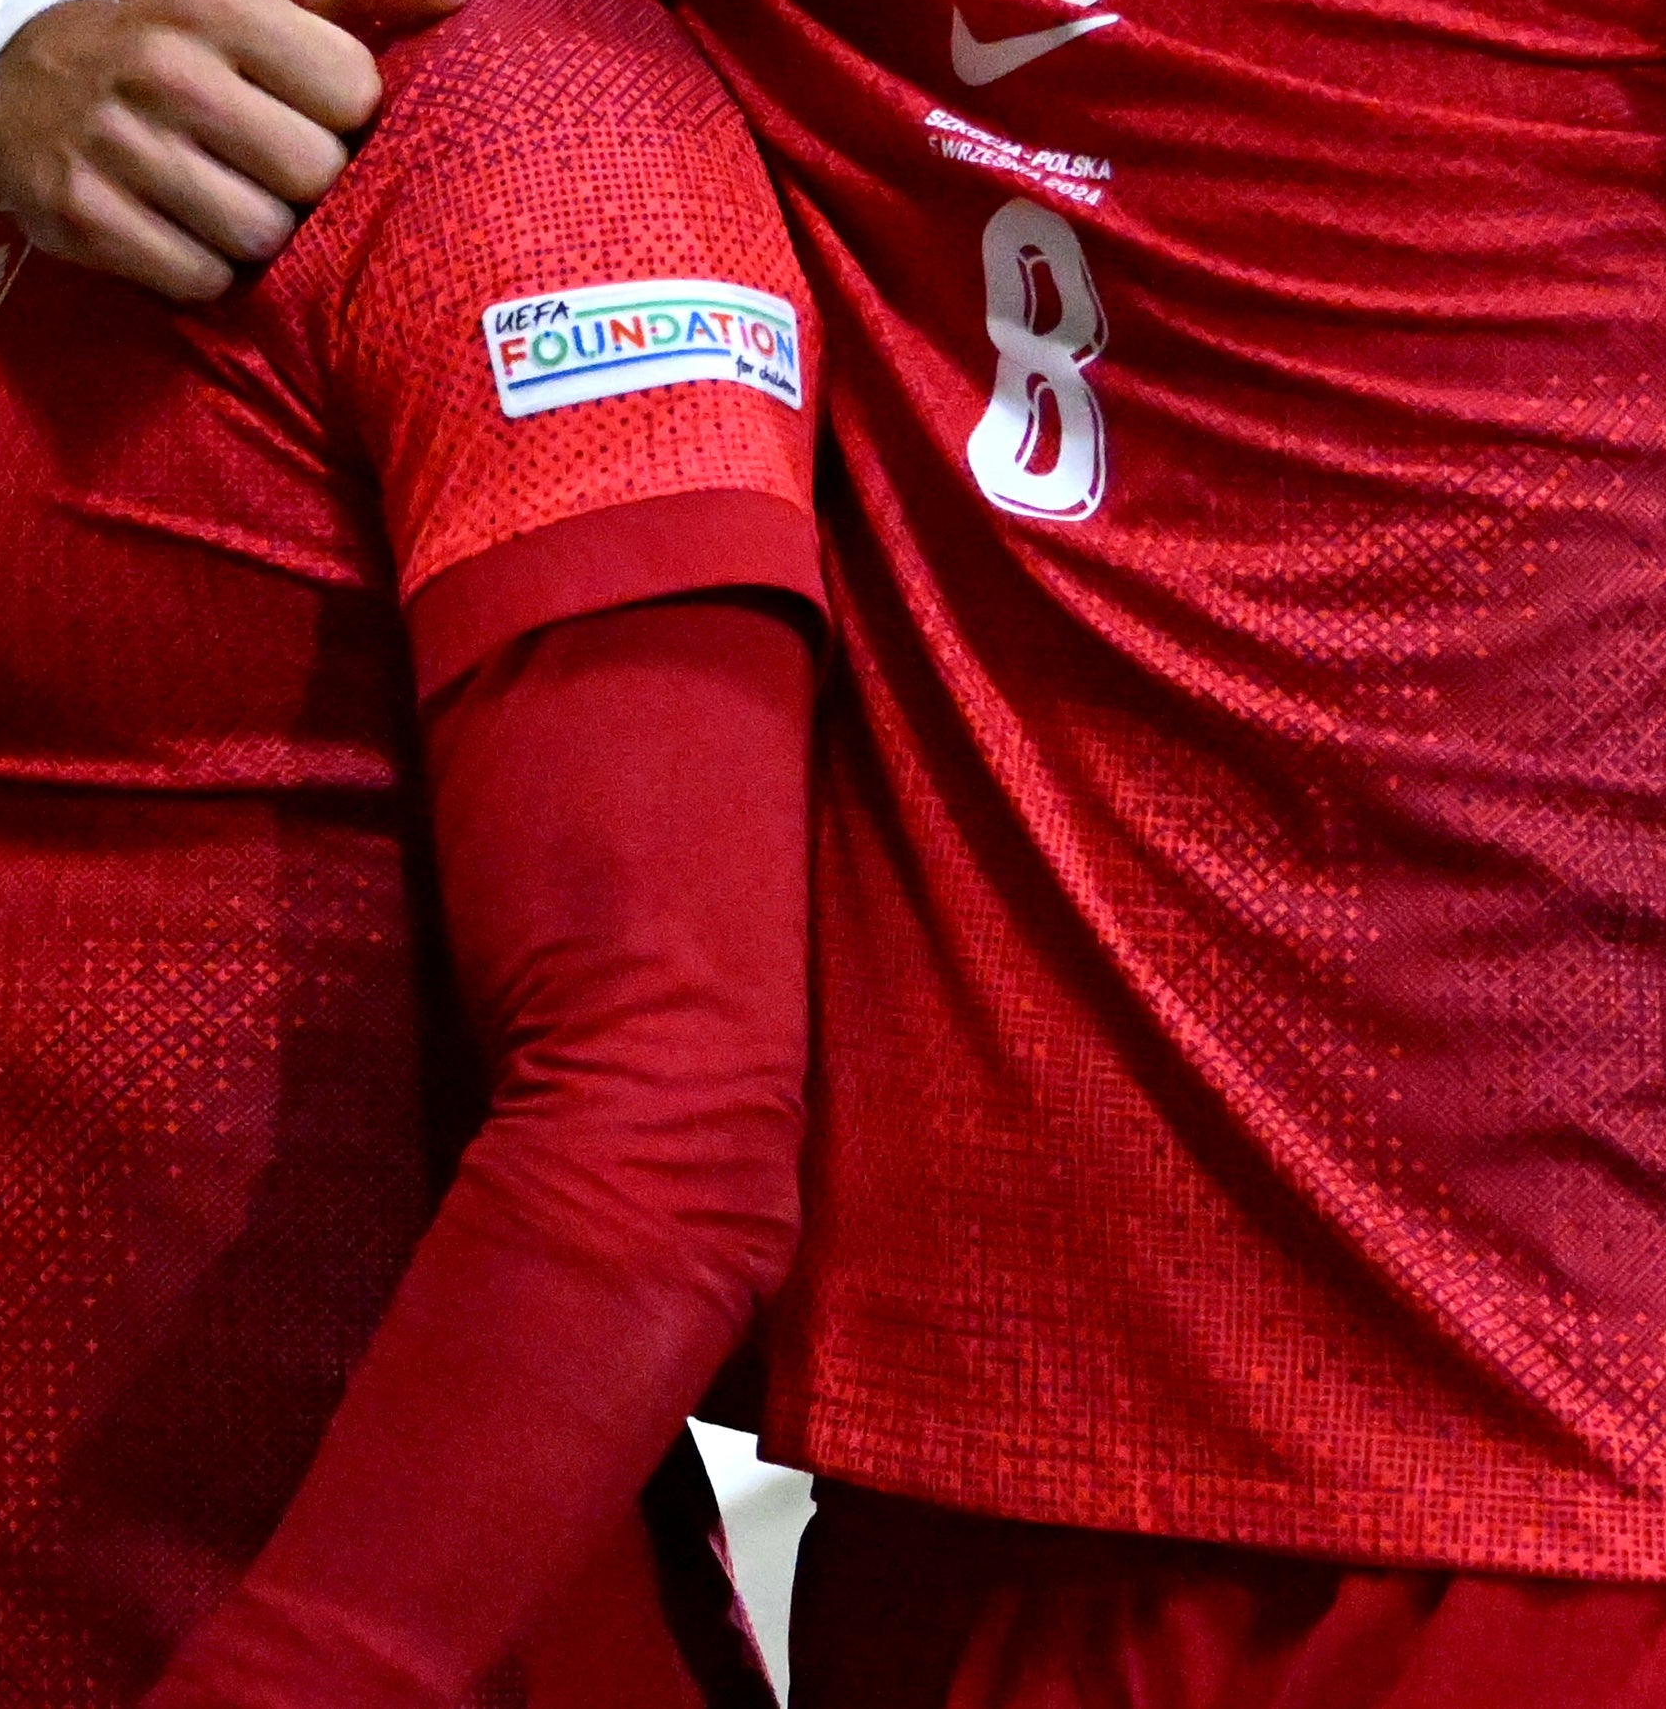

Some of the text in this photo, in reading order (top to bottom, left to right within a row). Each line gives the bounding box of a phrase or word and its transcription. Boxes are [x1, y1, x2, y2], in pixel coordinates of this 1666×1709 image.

[925, 109, 1023, 158] SZKOCJA
[1030, 150, 1112, 180] POLSKA
[1044, 178, 1102, 206] 2024
[494, 299, 570, 334] UEFA
[967, 196, 1109, 523] 8
